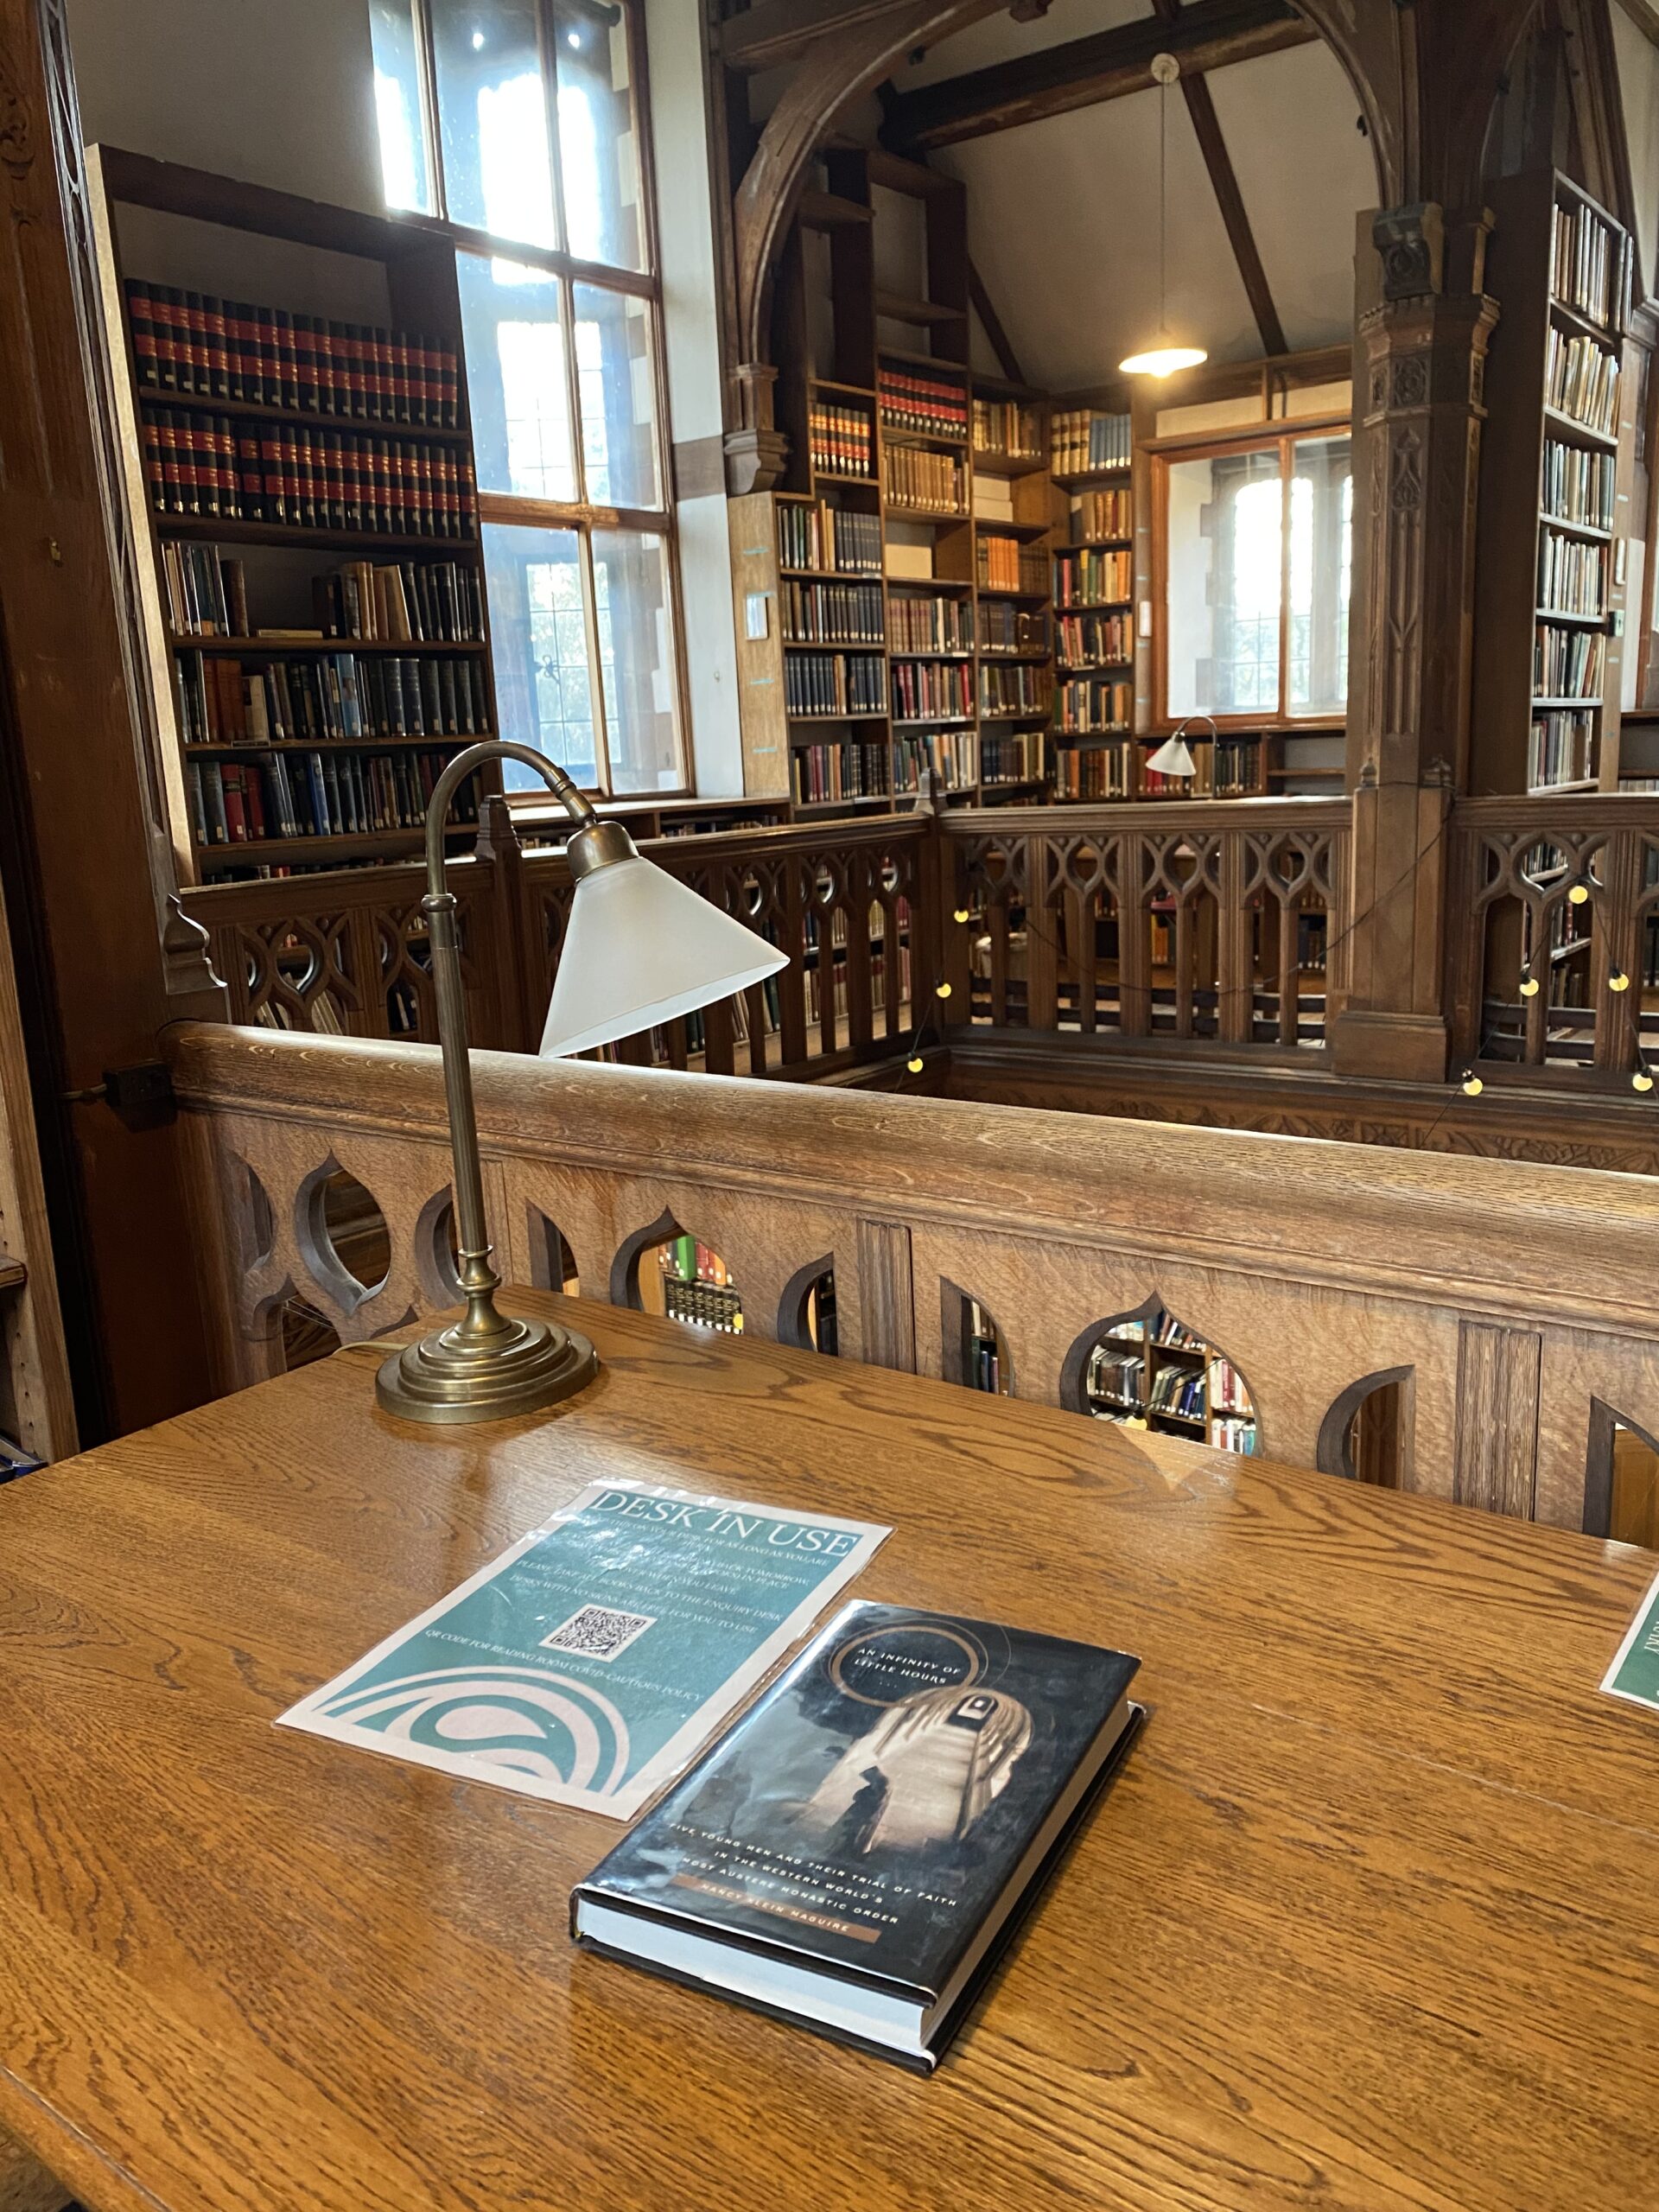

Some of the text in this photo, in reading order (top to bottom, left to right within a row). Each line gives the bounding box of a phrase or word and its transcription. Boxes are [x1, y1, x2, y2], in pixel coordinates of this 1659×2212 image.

[589, 1491, 859, 1557] DESK IN USE
[738, 1544, 769, 1554] LONG
[783, 1553, 809, 1561] YOU
[516, 1560, 553, 1571] PLEASE
[597, 1578, 635, 1588] BOOKS
[634, 1585, 663, 1594] BACK
[703, 1599, 753, 1613] ENQUIRY
[753, 1610, 784, 1620] DESK
[645, 1572, 679, 1581] WHEN
[678, 1578, 705, 1586] YOU
[704, 1583, 738, 1593] LEAVE
[746, 1568, 810, 1584] TOMORROW,
[755, 1578, 791, 1588] PLACE
[509, 1575, 543, 1586] DESKS
[541, 1582, 571, 1592] WITH
[690, 1614, 718, 1624] YOU
[734, 1624, 759, 1632] USE
[439, 1633, 471, 1644] CODE
[468, 1640, 492, 1649] FOR
[489, 1645, 537, 1660] READING
[535, 1656, 570, 1668] ROOM
[568, 1664, 662, 1690] COVID-CAUTIOUS
[661, 1686, 704, 1700] POLICY
[853, 1659, 947, 1683] LITTLE HOURS
[880, 1652, 938, 1669] INFINITY
[668, 1823, 696, 1834] FIVE
[700, 1832, 741, 1847] YOUNG
[746, 1845, 772, 1855] MEN
[776, 1853, 803, 1863] AND
[807, 1862, 846, 1876] THEIR
[851, 1874, 887, 1887] TRIAL
[917, 1892, 956, 1906] FAITH
[733, 1857, 756, 1866] THE
[761, 1865, 819, 1885] WESTERN
[824, 1883, 883, 1903] WORLD'S
[680, 1858, 898, 1923] MOST AUSTERE MONASTIC ORDER
[699, 1884, 849, 1931] NANCY KLEIN MAGUIRE
